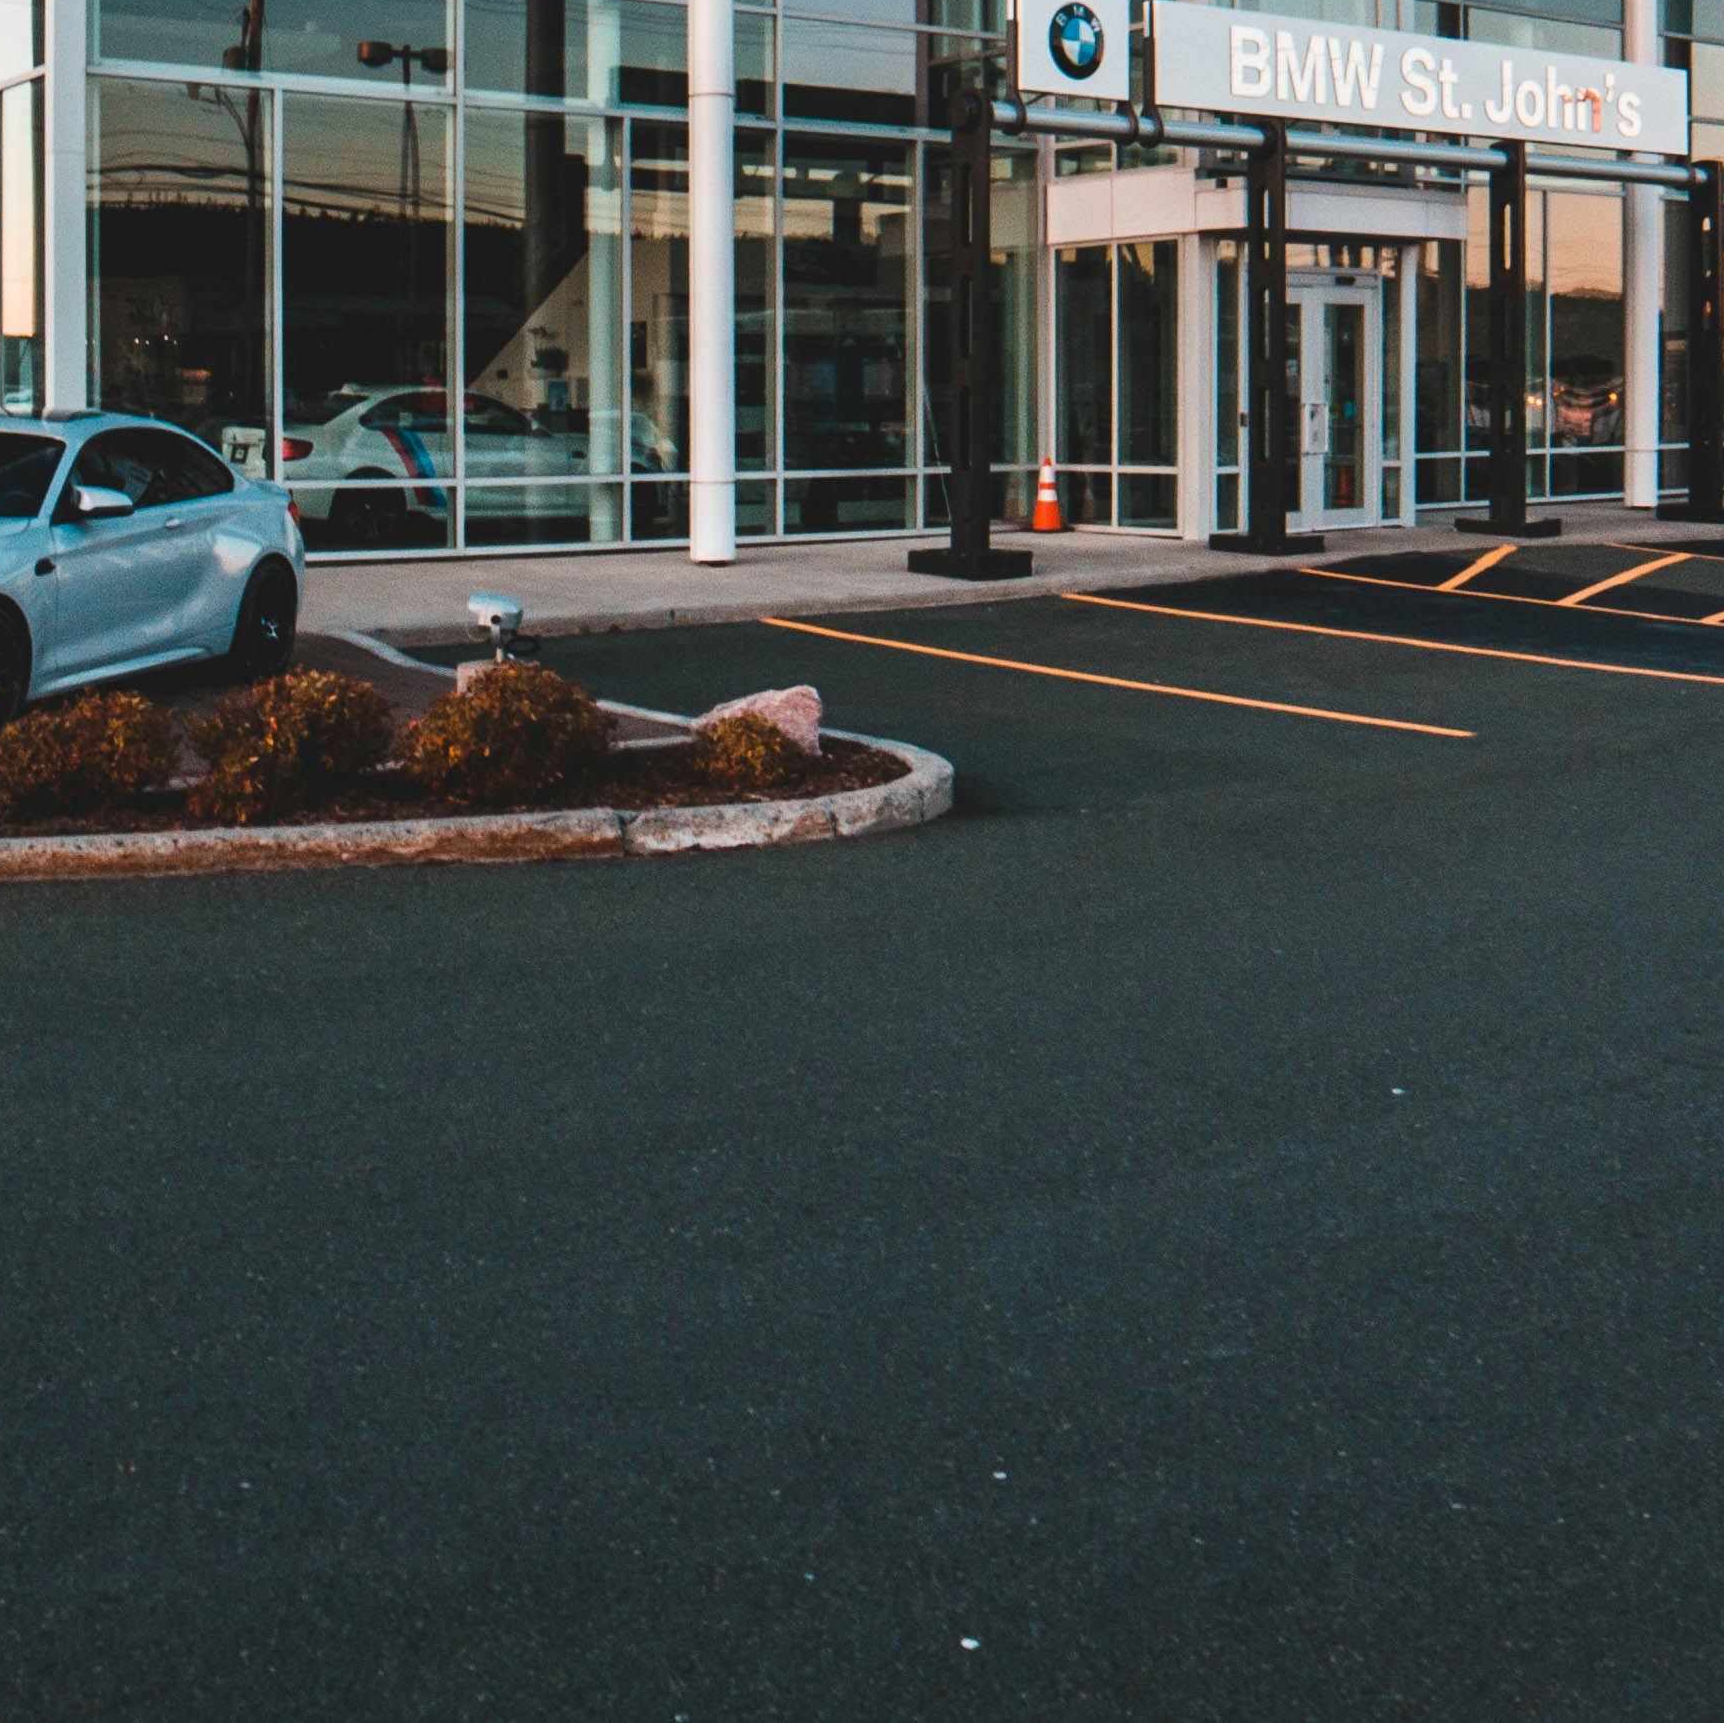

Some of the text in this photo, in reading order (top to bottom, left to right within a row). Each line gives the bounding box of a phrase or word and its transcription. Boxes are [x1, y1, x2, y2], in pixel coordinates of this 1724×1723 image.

[1056, 4, 1101, 32] BMW
[1229, 24, 1643, 138] BMW St. John's
